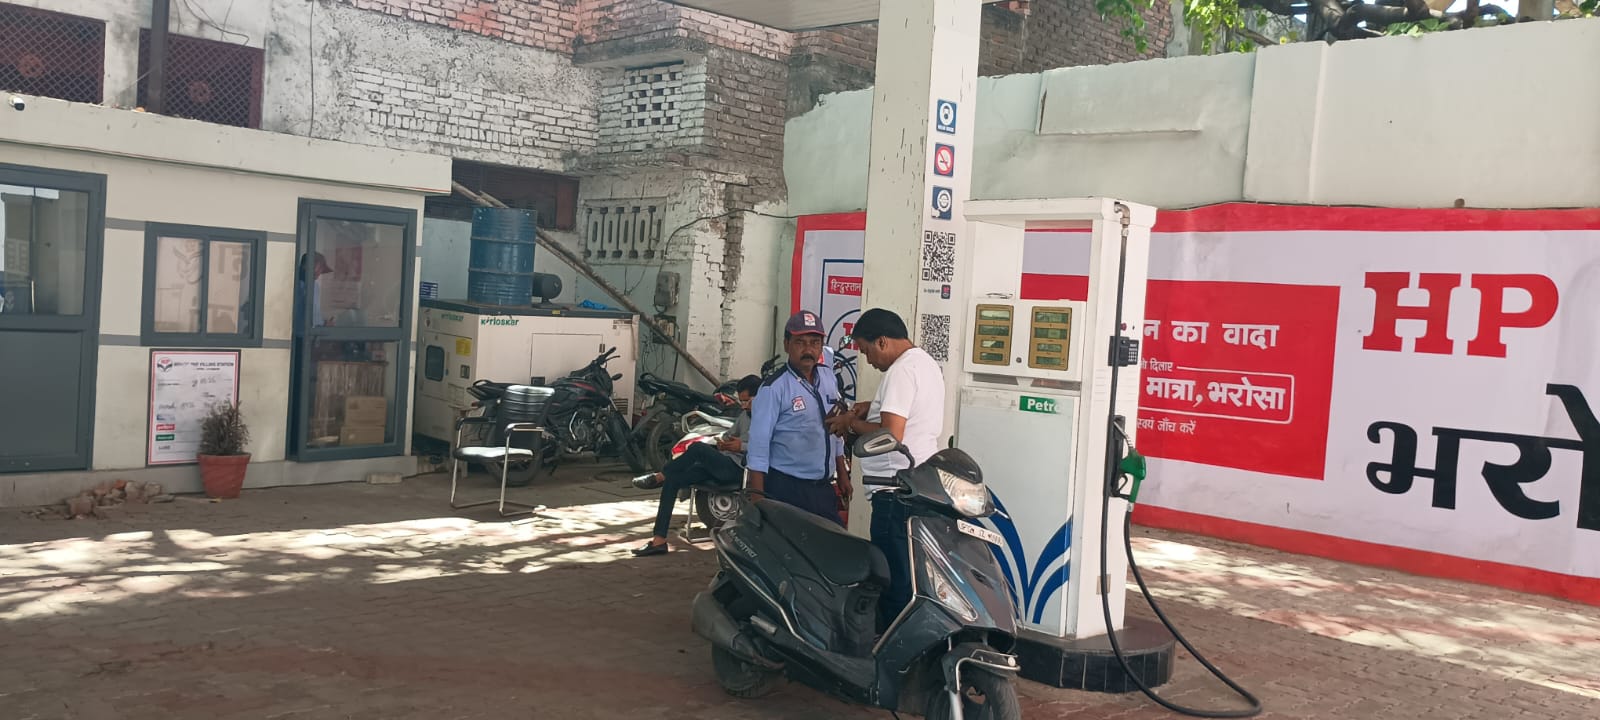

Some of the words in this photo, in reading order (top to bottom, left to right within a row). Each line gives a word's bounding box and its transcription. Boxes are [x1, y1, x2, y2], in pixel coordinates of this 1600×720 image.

[831, 278, 861, 294] हिन्दुस्तान
[1362, 271, 1559, 358] HP
[1171, 320, 1209, 344] का
[1222, 323, 1280, 350] वादा
[1207, 376, 1286, 411] भरोसा
[1179, 419, 1197, 435] करें
